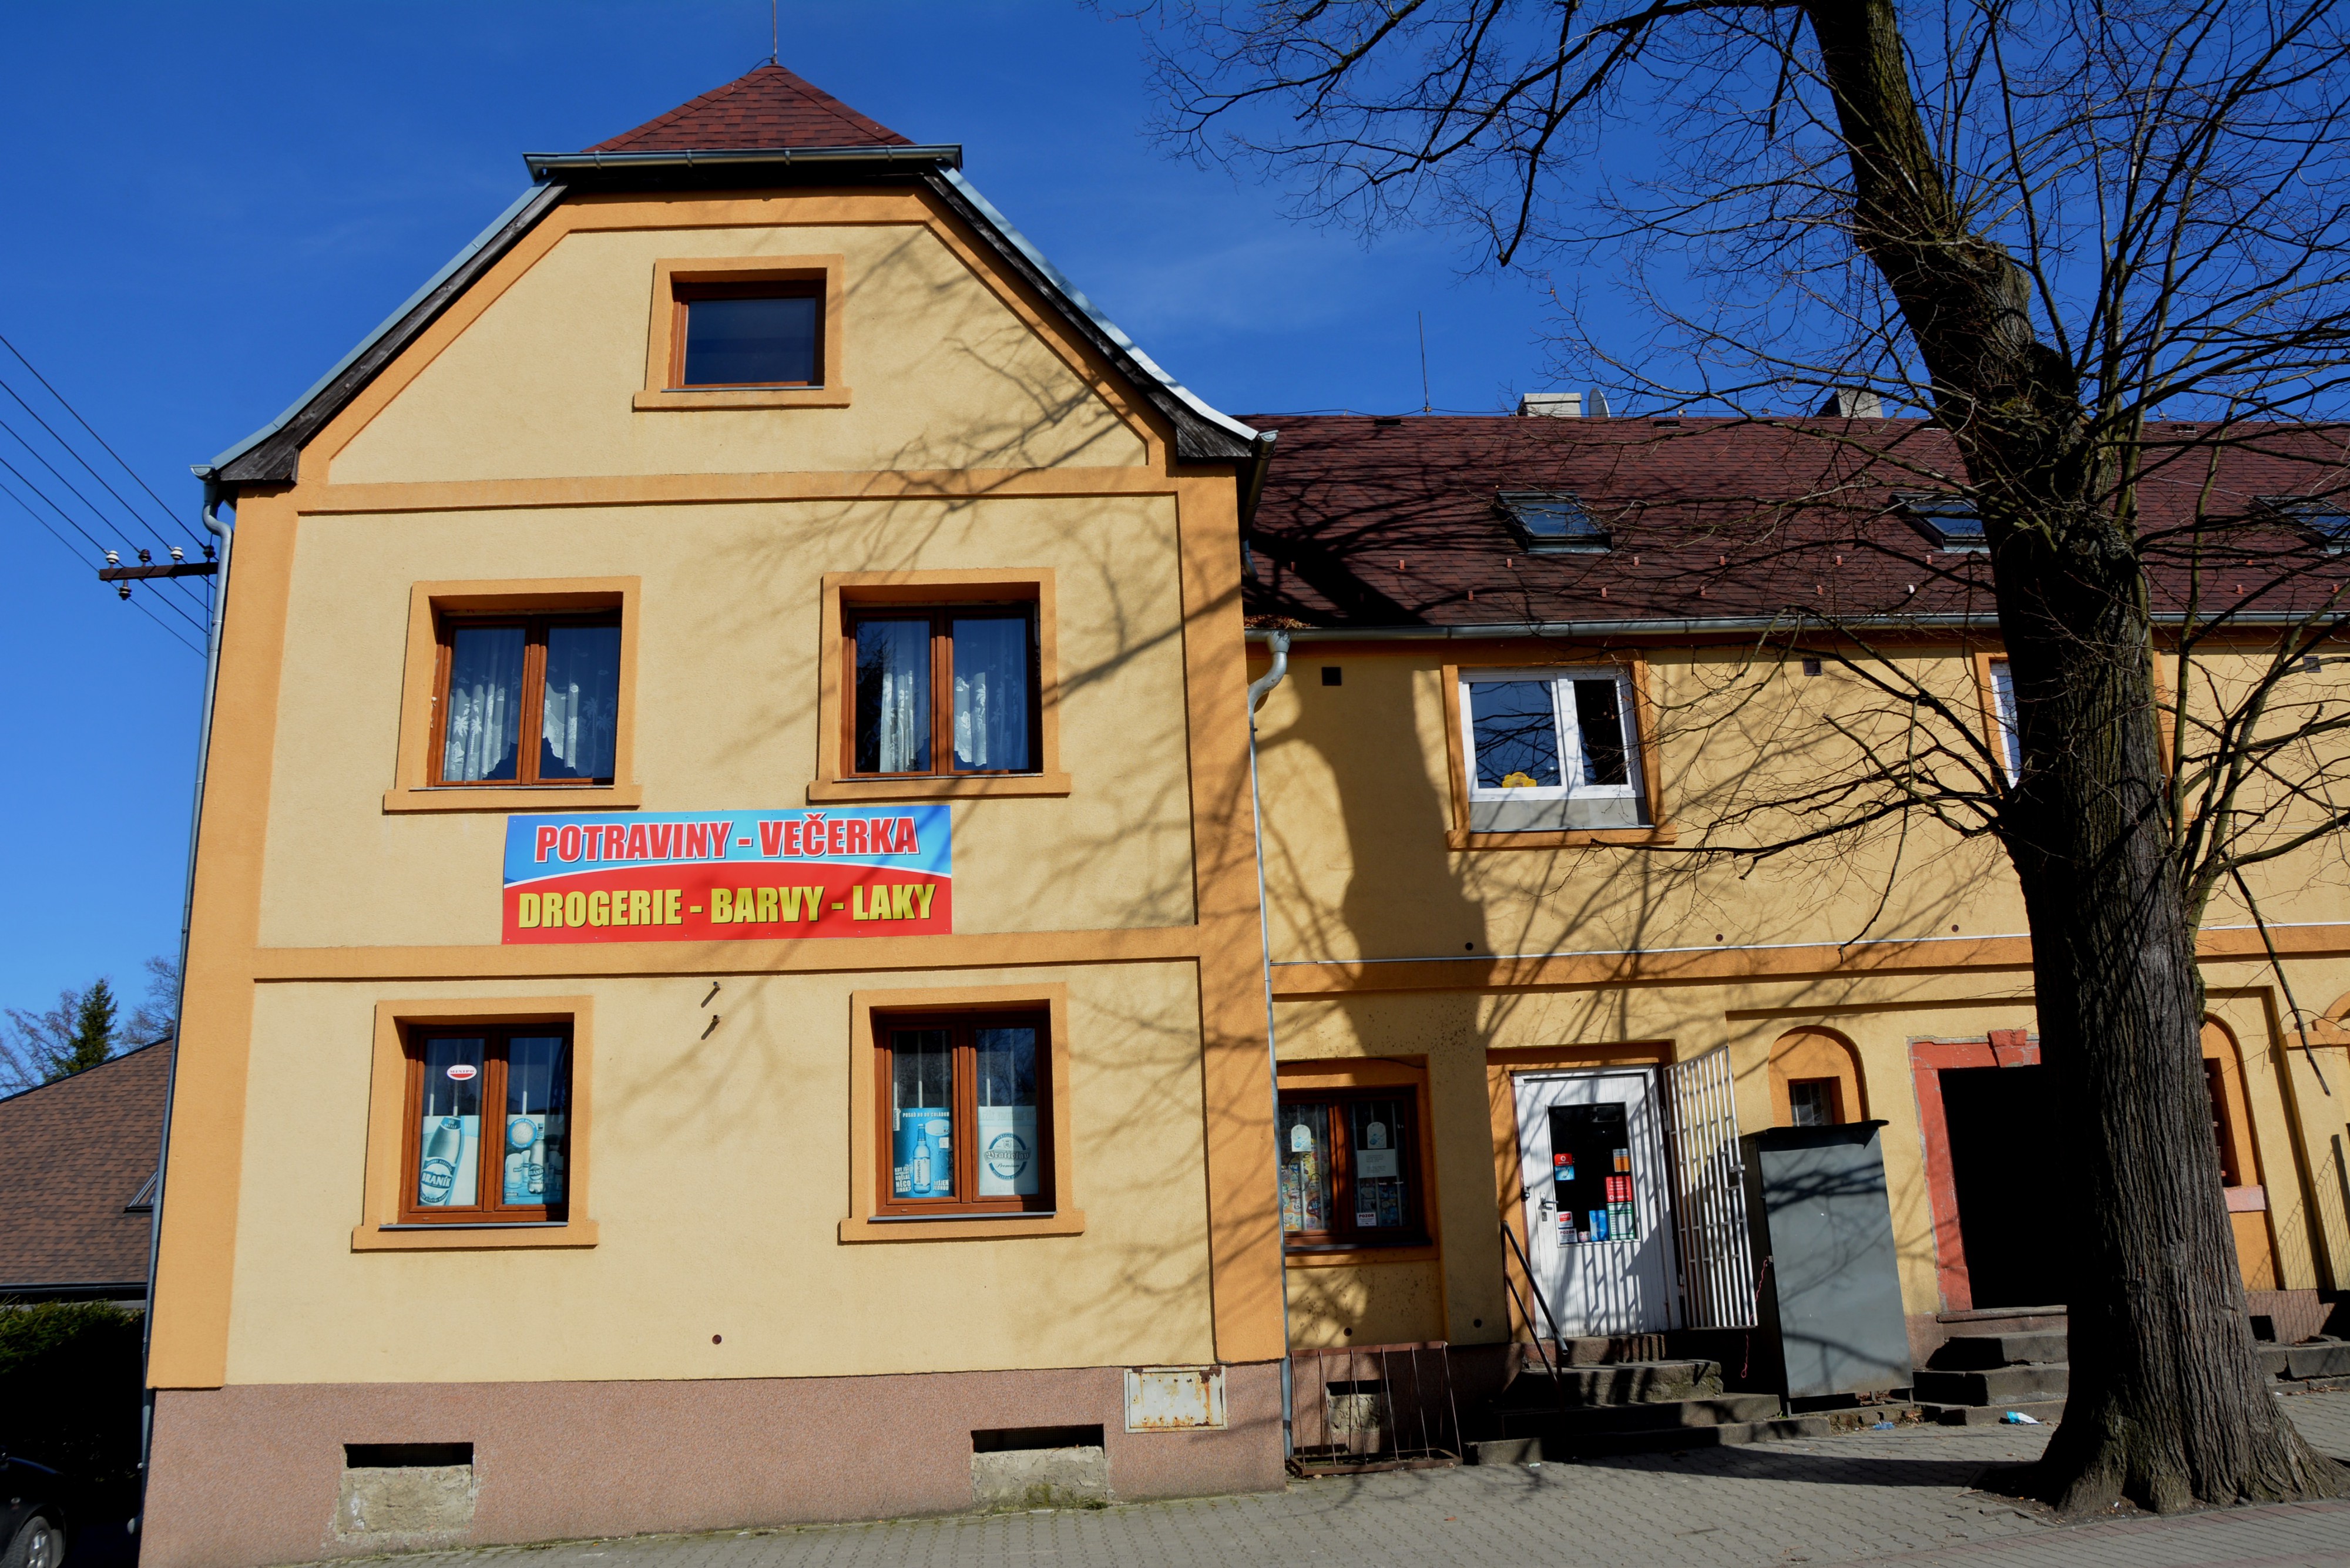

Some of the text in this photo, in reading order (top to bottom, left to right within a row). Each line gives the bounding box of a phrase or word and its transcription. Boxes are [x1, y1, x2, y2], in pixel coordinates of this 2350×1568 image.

[535, 812, 921, 863] POTRAVINY - VEČERKA
[518, 889, 683, 928] DROGERIE
[711, 886, 824, 925] BARVY
[831, 902, 844, 910] -
[852, 884, 935, 921] LAKY
[422, 1173, 451, 1187] BRANÍK
